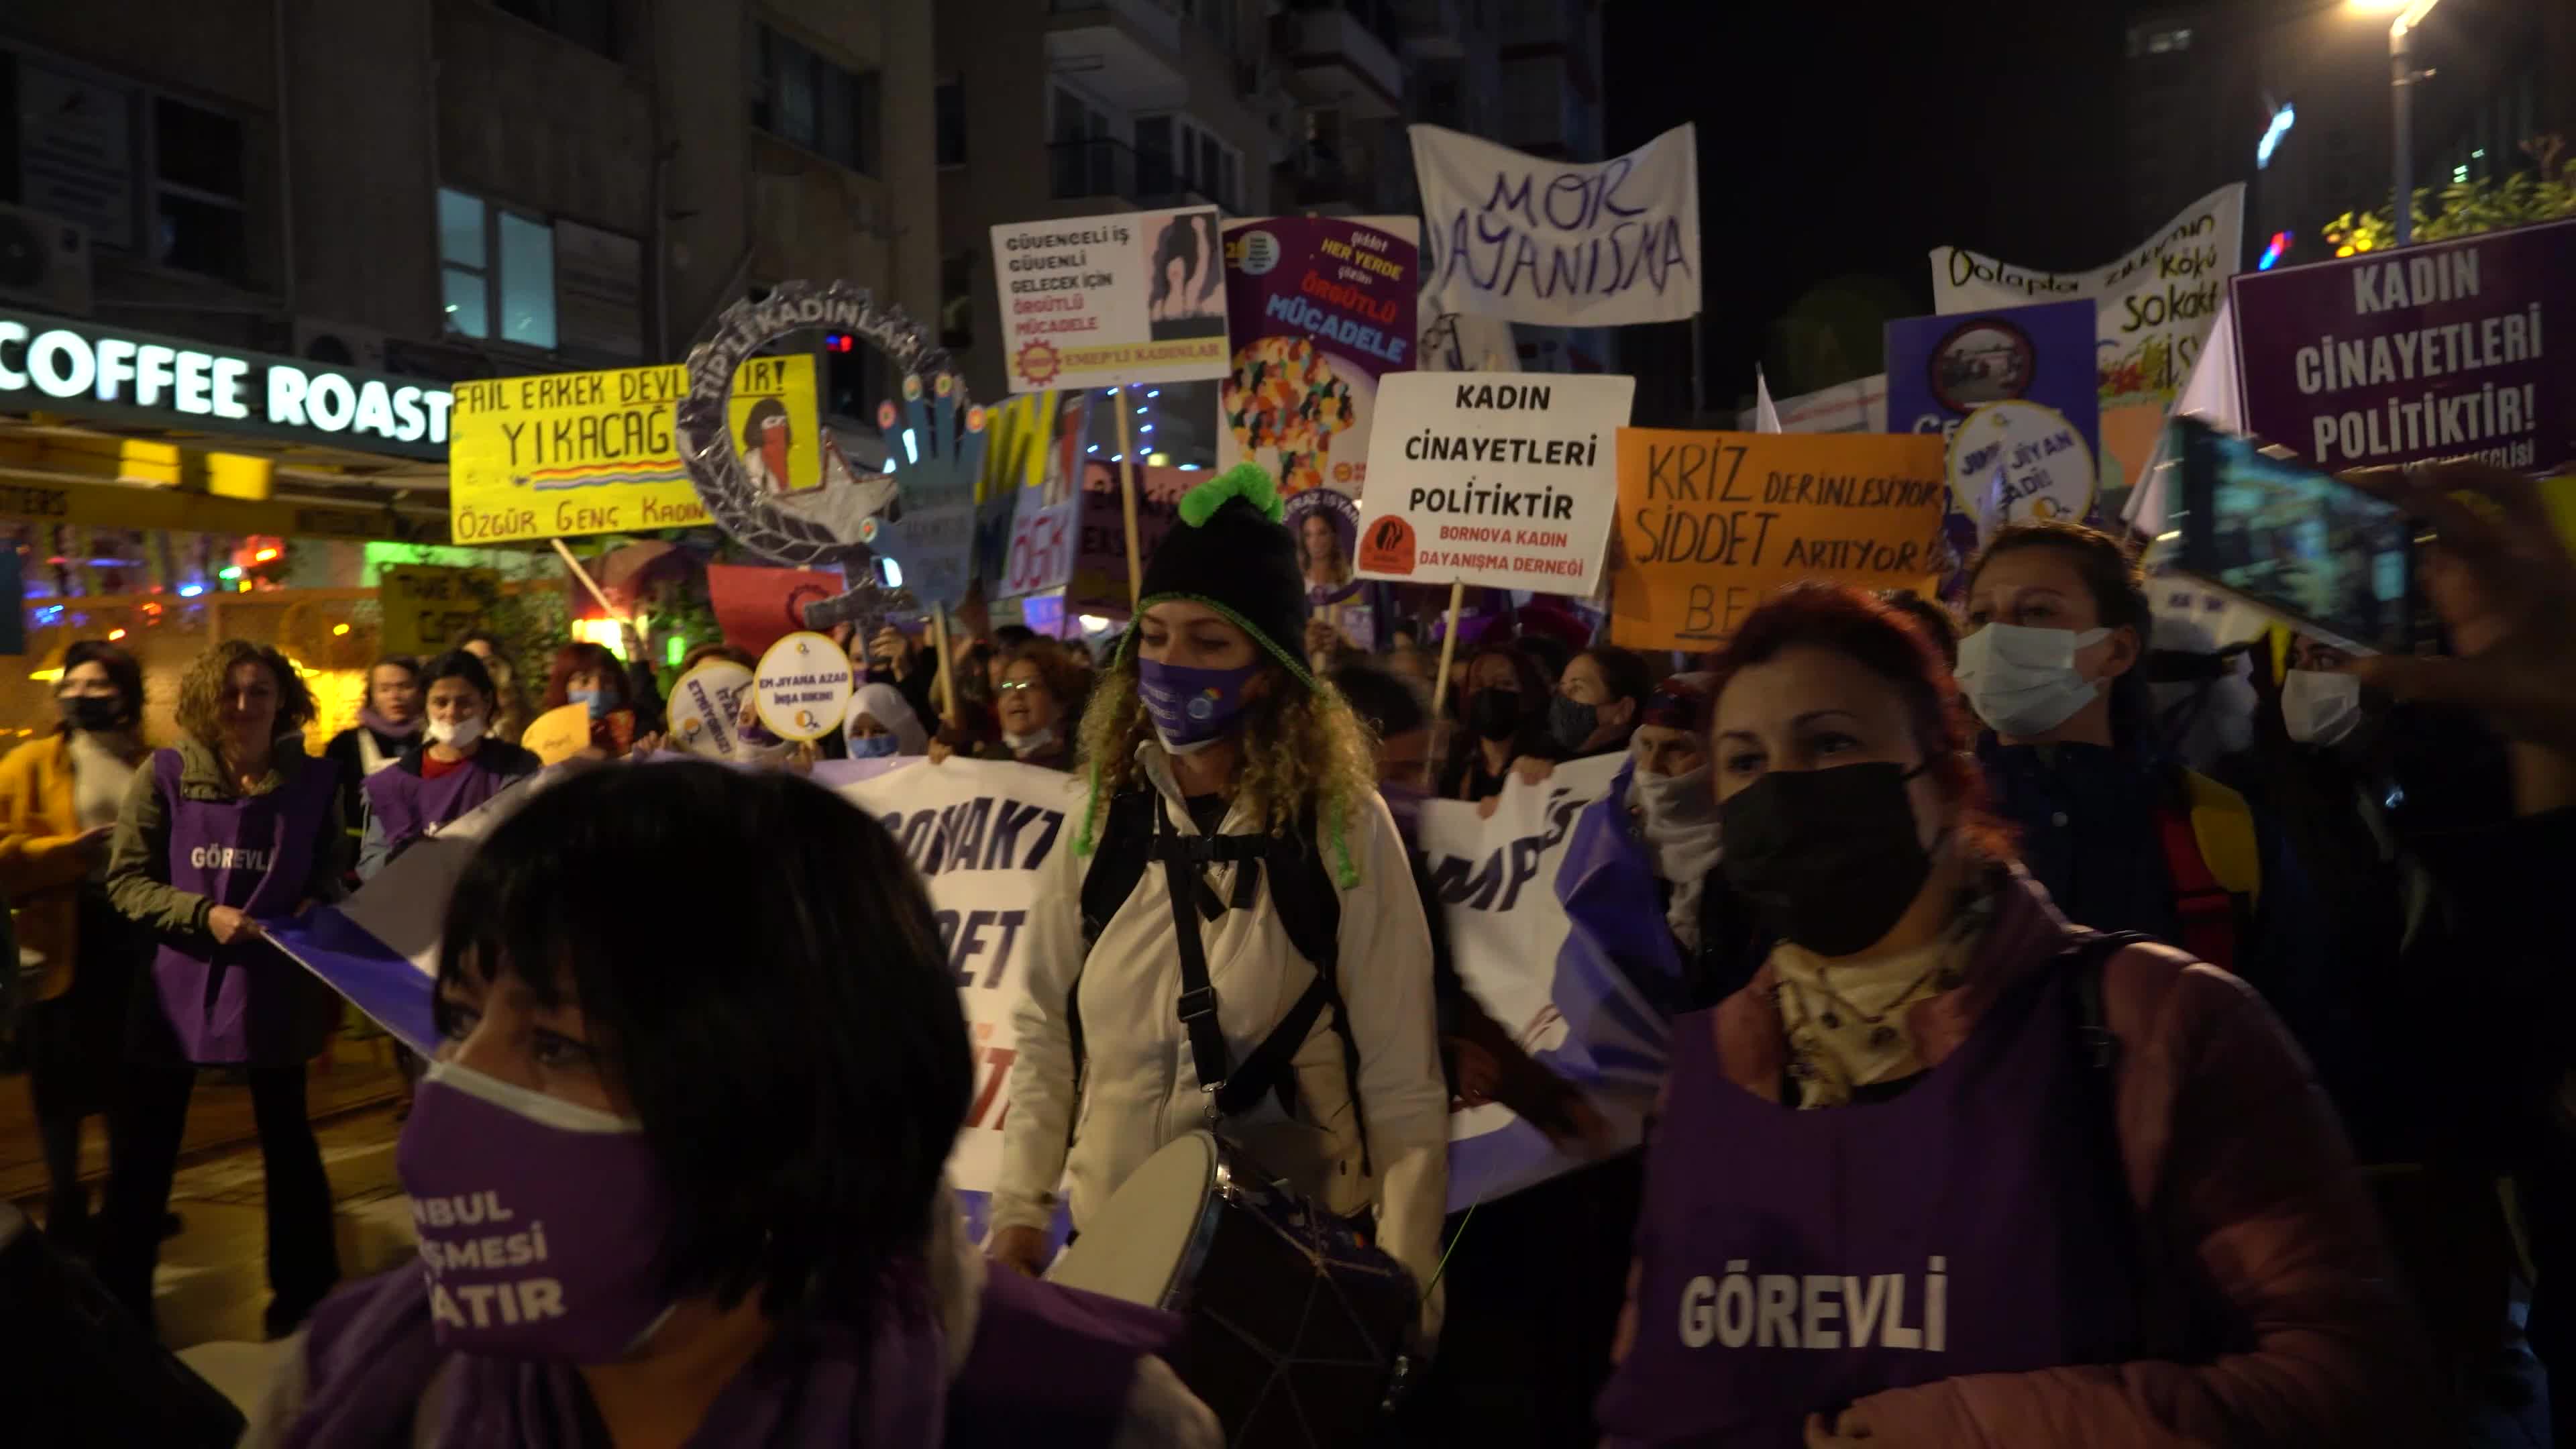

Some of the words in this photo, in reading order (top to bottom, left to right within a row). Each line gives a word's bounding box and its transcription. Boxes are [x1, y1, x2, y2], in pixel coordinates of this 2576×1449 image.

[1483, 158, 1648, 229] MOR
[1010, 275, 1080, 294] GELECEK
[1083, 272, 1114, 290] İÇİN
[2352, 248, 2480, 315] KADIN
[1016, 316, 1099, 335] MÜCADELE
[1266, 292, 1407, 363] MÜCADELE
[2295, 302, 2544, 394] CİNAYETLERİ
[0, 321, 249, 419] COFFEE
[267, 366, 454, 443] ROAST
[522, 376, 603, 409] ERKEK
[1456, 385, 1551, 410] KADIN
[501, 407, 671, 467] YIKACAĞ
[1405, 428, 1598, 467] CİNAYETLERİ
[2312, 382, 2536, 464] POLİTİKTİR!
[1648, 437, 1752, 502] KRİZ
[458, 506, 535, 539] ÖZGÜR
[1409, 477, 1574, 520] POLİTİKTİR
[1440, 525, 1512, 544] BORNOVA
[1515, 531, 1568, 548] KADIN
[1419, 551, 1509, 572] DAYANIŞMA
[1513, 555, 1584, 577] DERNEĞİ
[1678, 1254, 1947, 1352] GÖREVLİ
